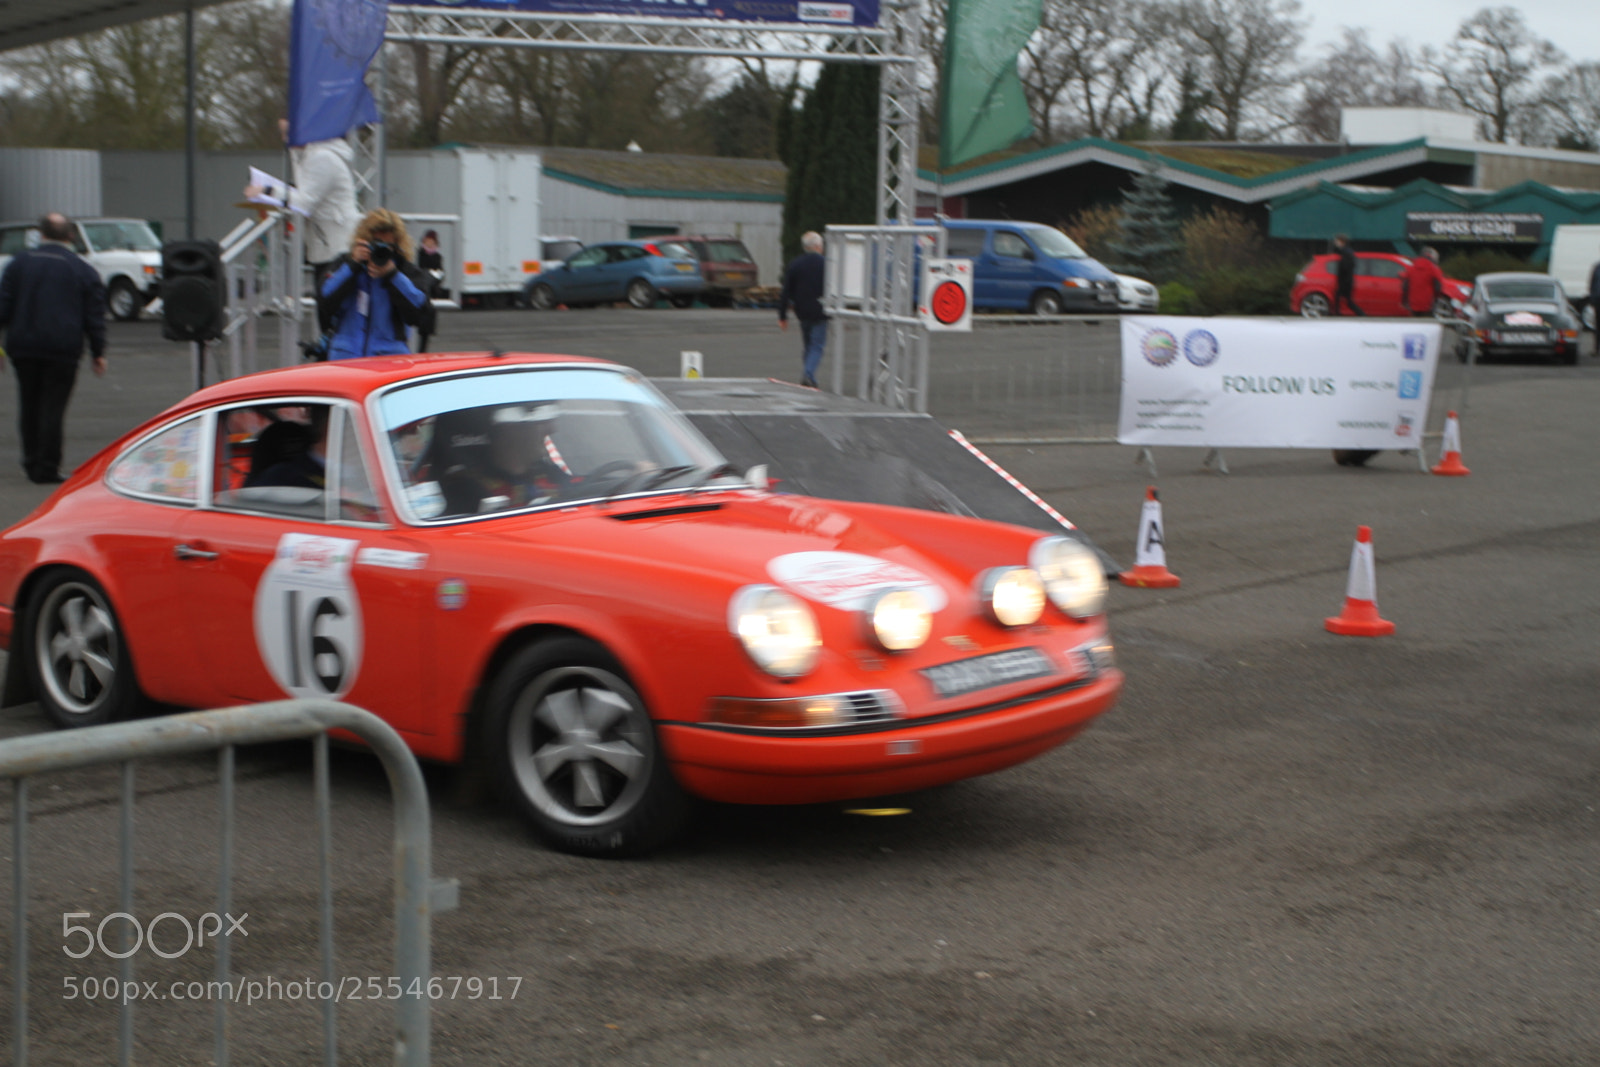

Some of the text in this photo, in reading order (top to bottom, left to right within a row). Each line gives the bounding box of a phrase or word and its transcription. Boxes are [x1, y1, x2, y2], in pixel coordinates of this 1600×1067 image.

[1222, 375, 1304, 394] FOLLOW
[1309, 377, 1335, 395] US
[1144, 520, 1167, 553] A
[283, 590, 349, 694] 16
